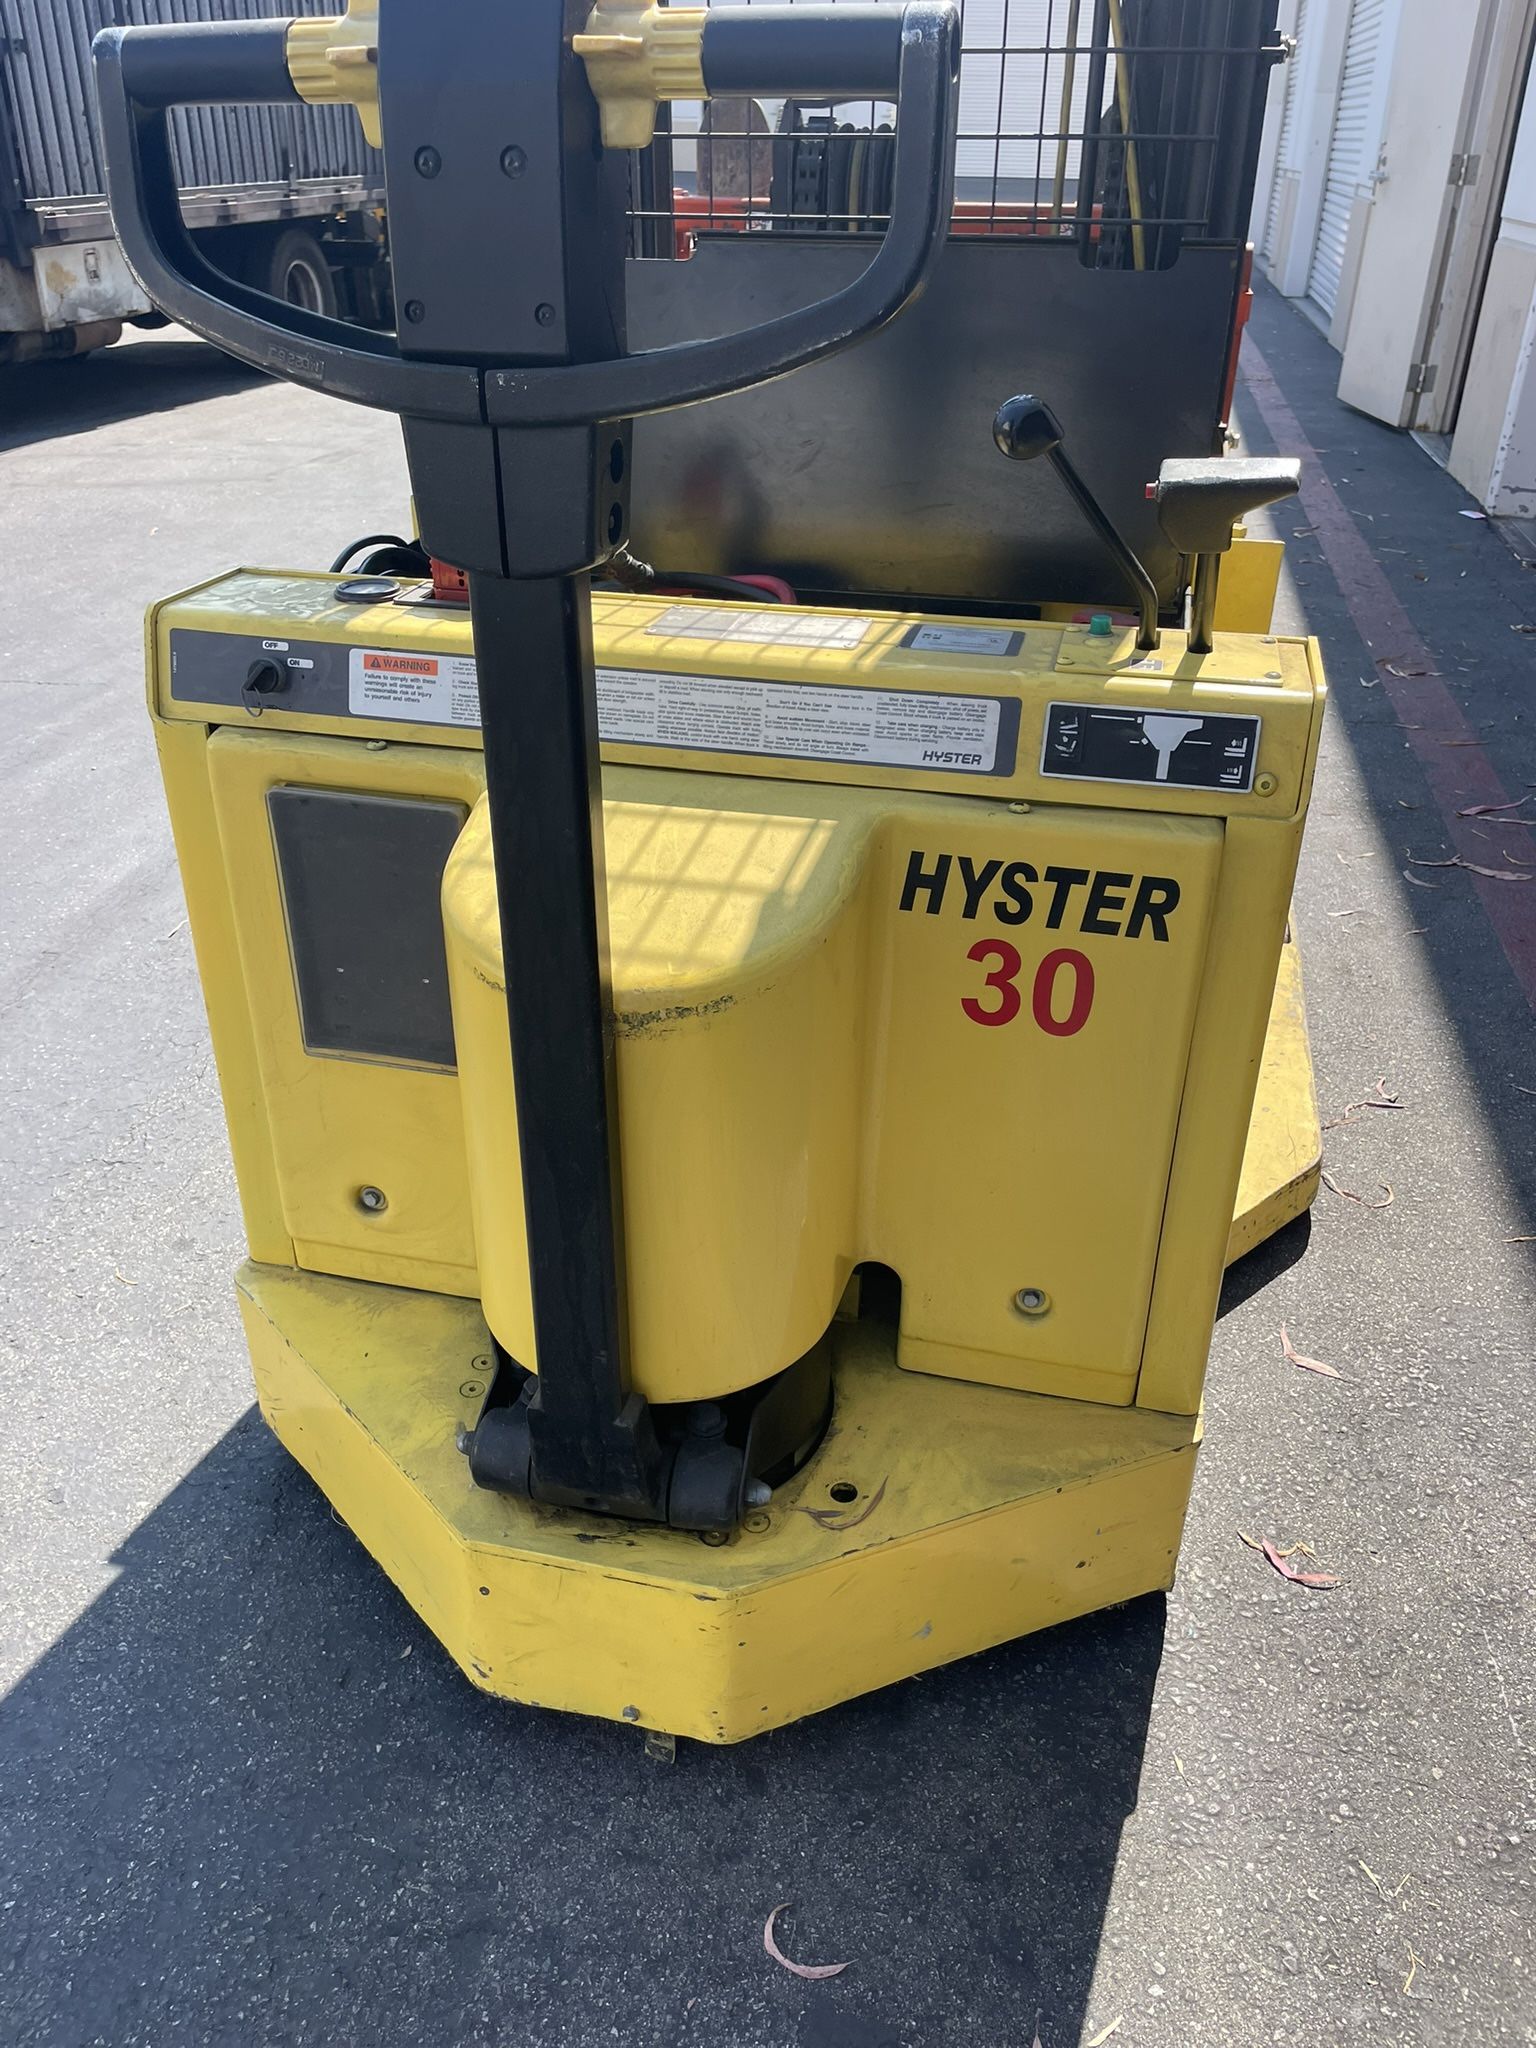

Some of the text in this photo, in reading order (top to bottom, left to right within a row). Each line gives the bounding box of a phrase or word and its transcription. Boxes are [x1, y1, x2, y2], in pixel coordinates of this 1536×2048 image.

[383, 658, 430, 672] WARNING
[922, 750, 982, 766] HYSTER
[899, 851, 1181, 943] HYSTER
[961, 938, 1095, 1037] 30
